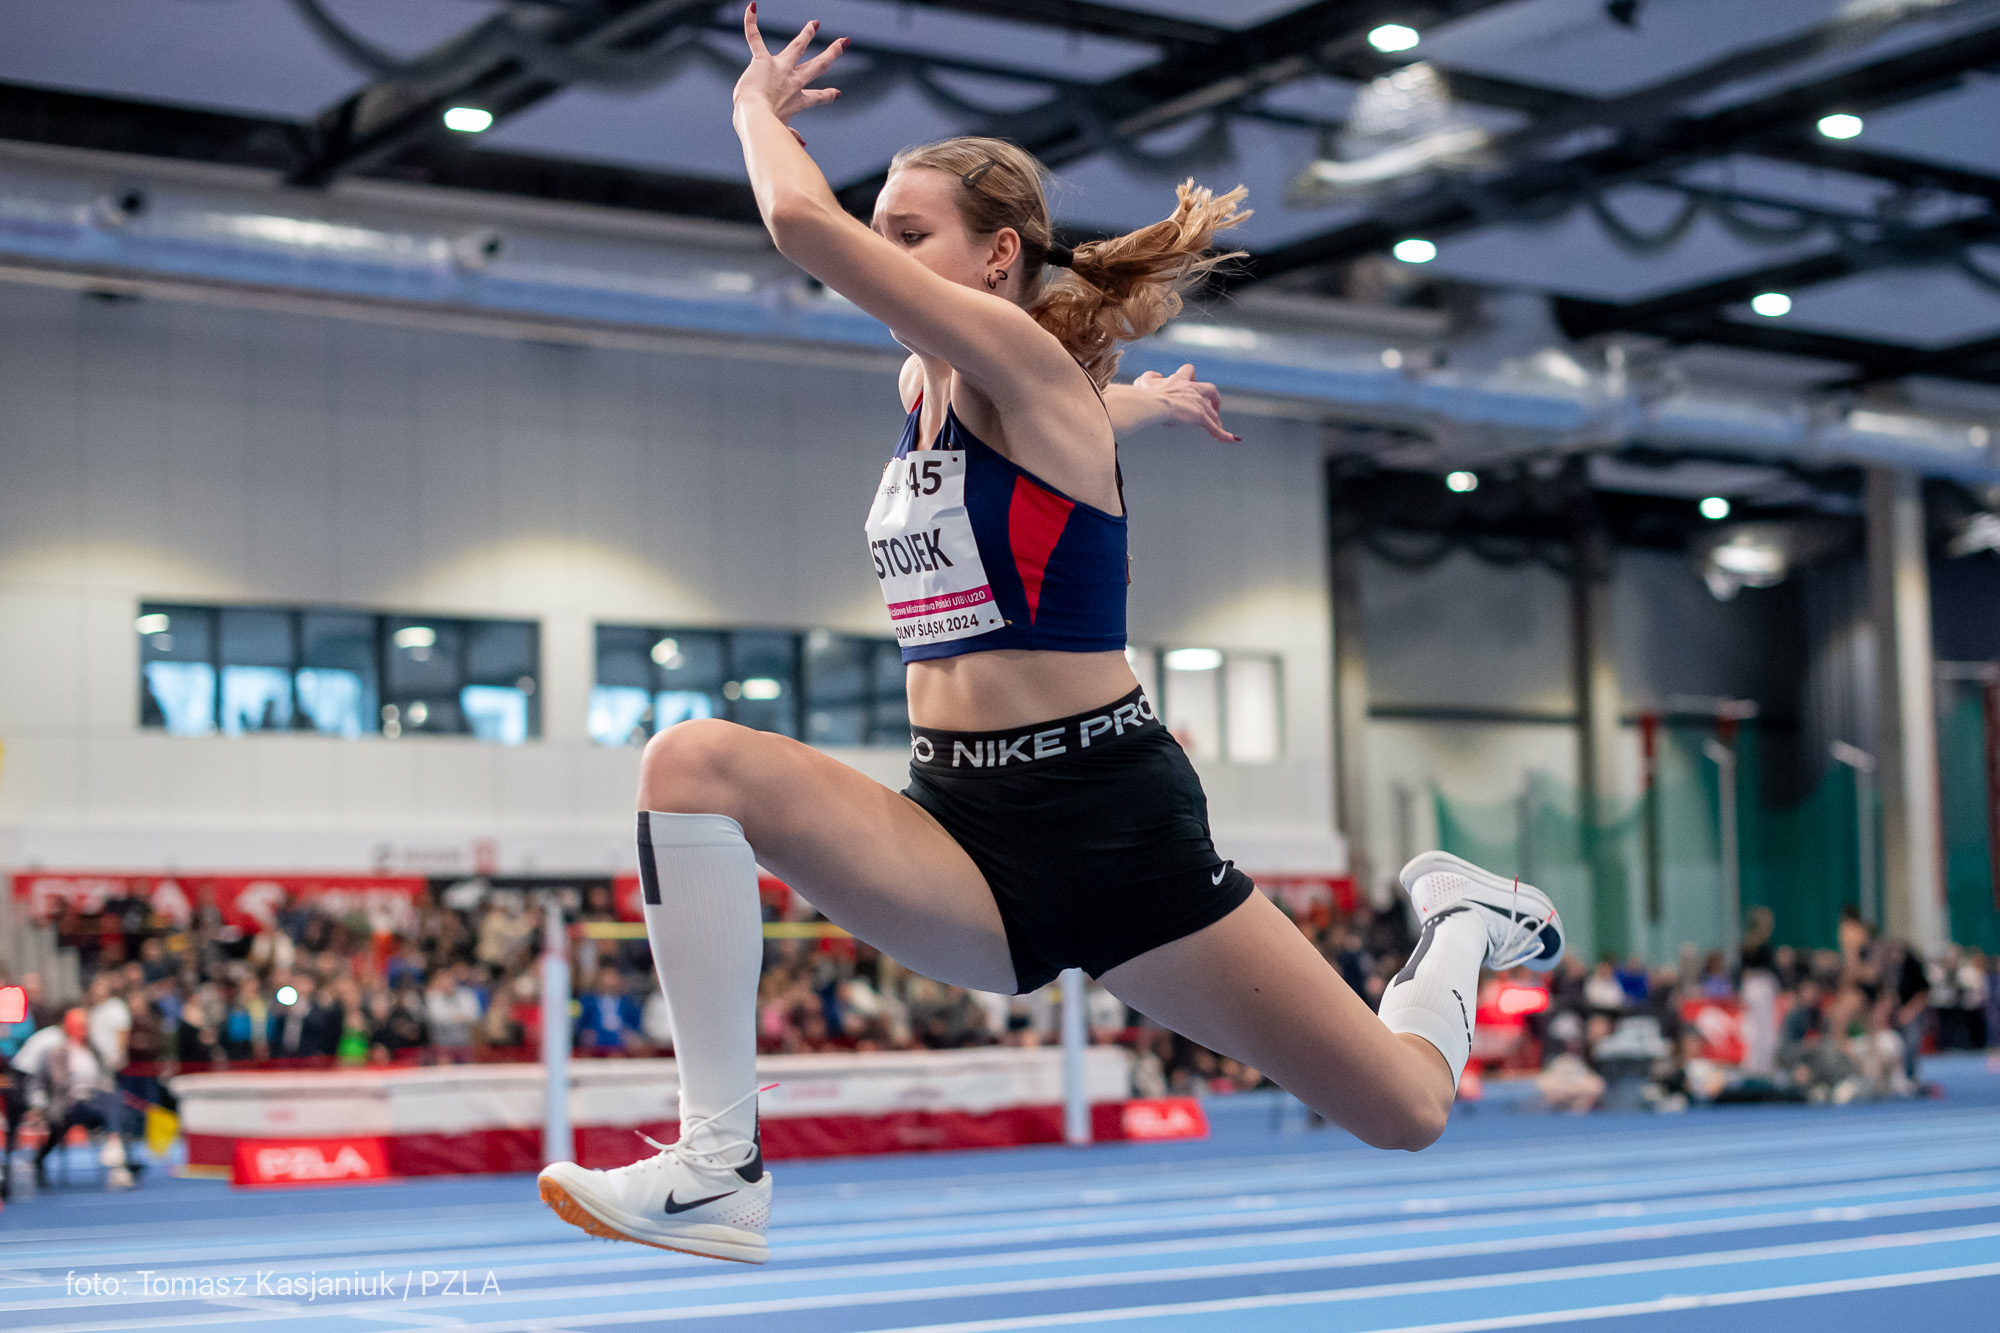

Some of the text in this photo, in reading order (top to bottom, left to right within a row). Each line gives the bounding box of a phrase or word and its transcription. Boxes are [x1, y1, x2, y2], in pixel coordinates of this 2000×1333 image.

[905, 460, 942, 498] 45
[871, 528, 954, 580] STOJEK
[935, 598, 951, 609] Polski
[967, 590, 986, 603] U20
[894, 613, 979, 640] OLNY ŚLĄSK 2024
[952, 727, 1067, 768] NIKE
[1080, 694, 1155, 748] PRO
